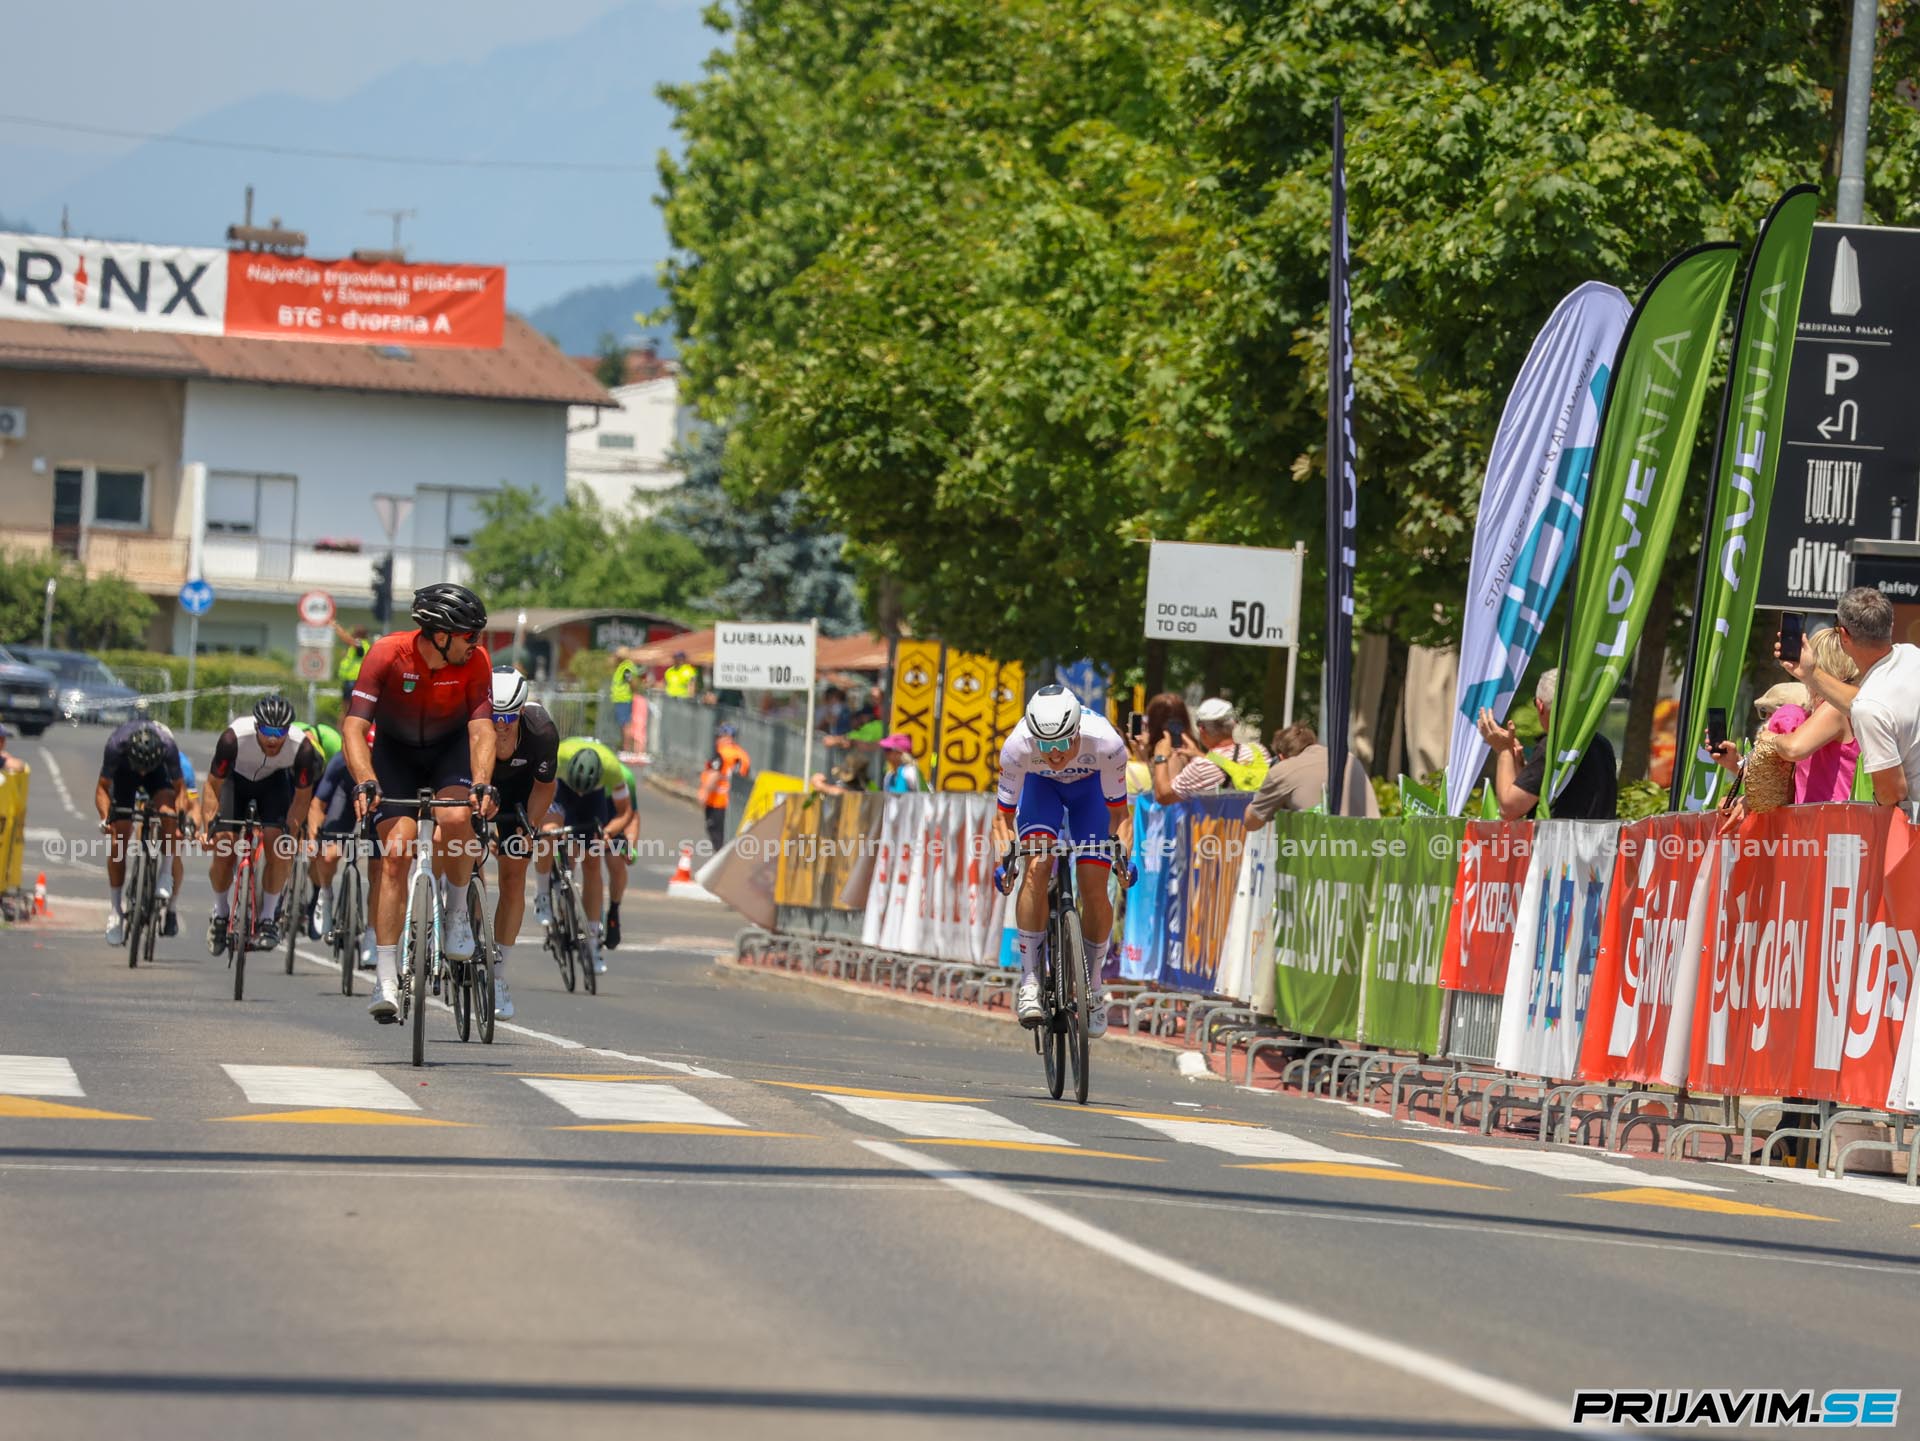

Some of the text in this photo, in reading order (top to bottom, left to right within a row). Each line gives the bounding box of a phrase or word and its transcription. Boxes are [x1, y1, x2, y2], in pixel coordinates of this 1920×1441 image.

[0, 250, 209, 316] RINX
[278, 305, 322, 328] BTC
[341, 309, 429, 334] dvorana
[433, 313, 452, 334] A
[1825, 353, 1859, 395] P
[1805, 459, 1862, 519] TWENTY
[1878, 580, 1919, 597] Safety
[1158, 603, 1218, 618] DO CILJA
[1156, 620, 1197, 633] TO GO
[723, 632, 805, 646] LJUBLJANA
